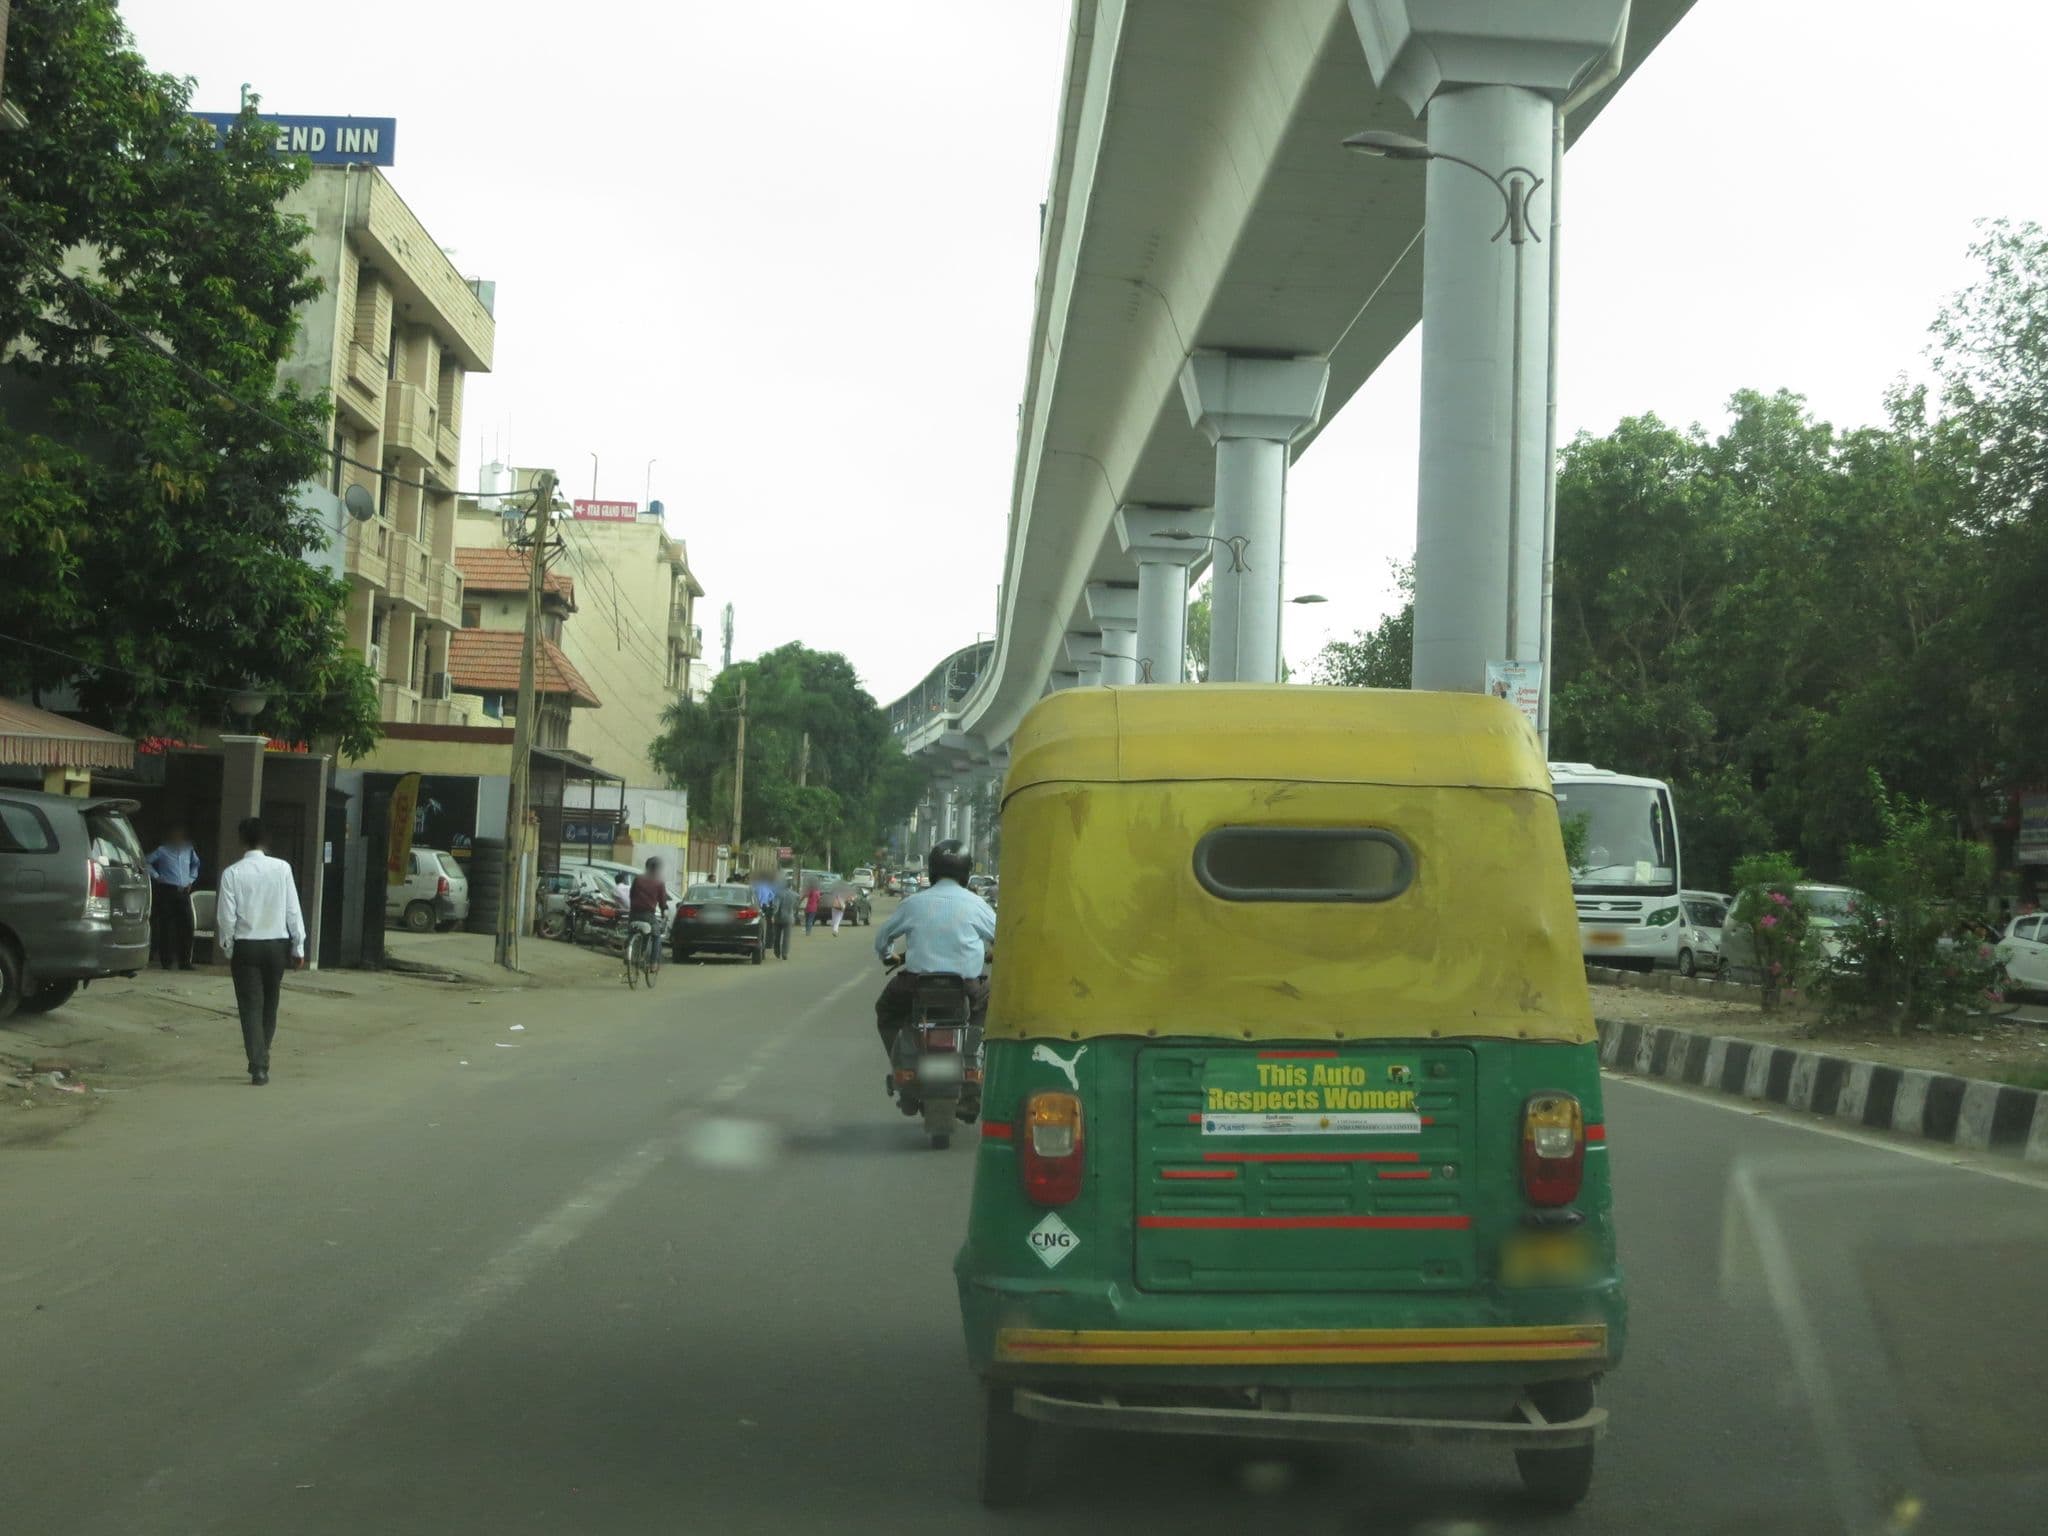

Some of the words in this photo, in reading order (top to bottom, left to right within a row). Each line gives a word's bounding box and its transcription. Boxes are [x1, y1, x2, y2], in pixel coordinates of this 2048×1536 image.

[336, 127, 379, 153] INN
[1257, 1064, 1308, 1087] This
[1312, 1065, 1366, 1087] Auto
[1208, 1088, 1320, 1112] Respects
[1324, 1088, 1415, 1110] Women
[1032, 1232, 1070, 1247] CNG
